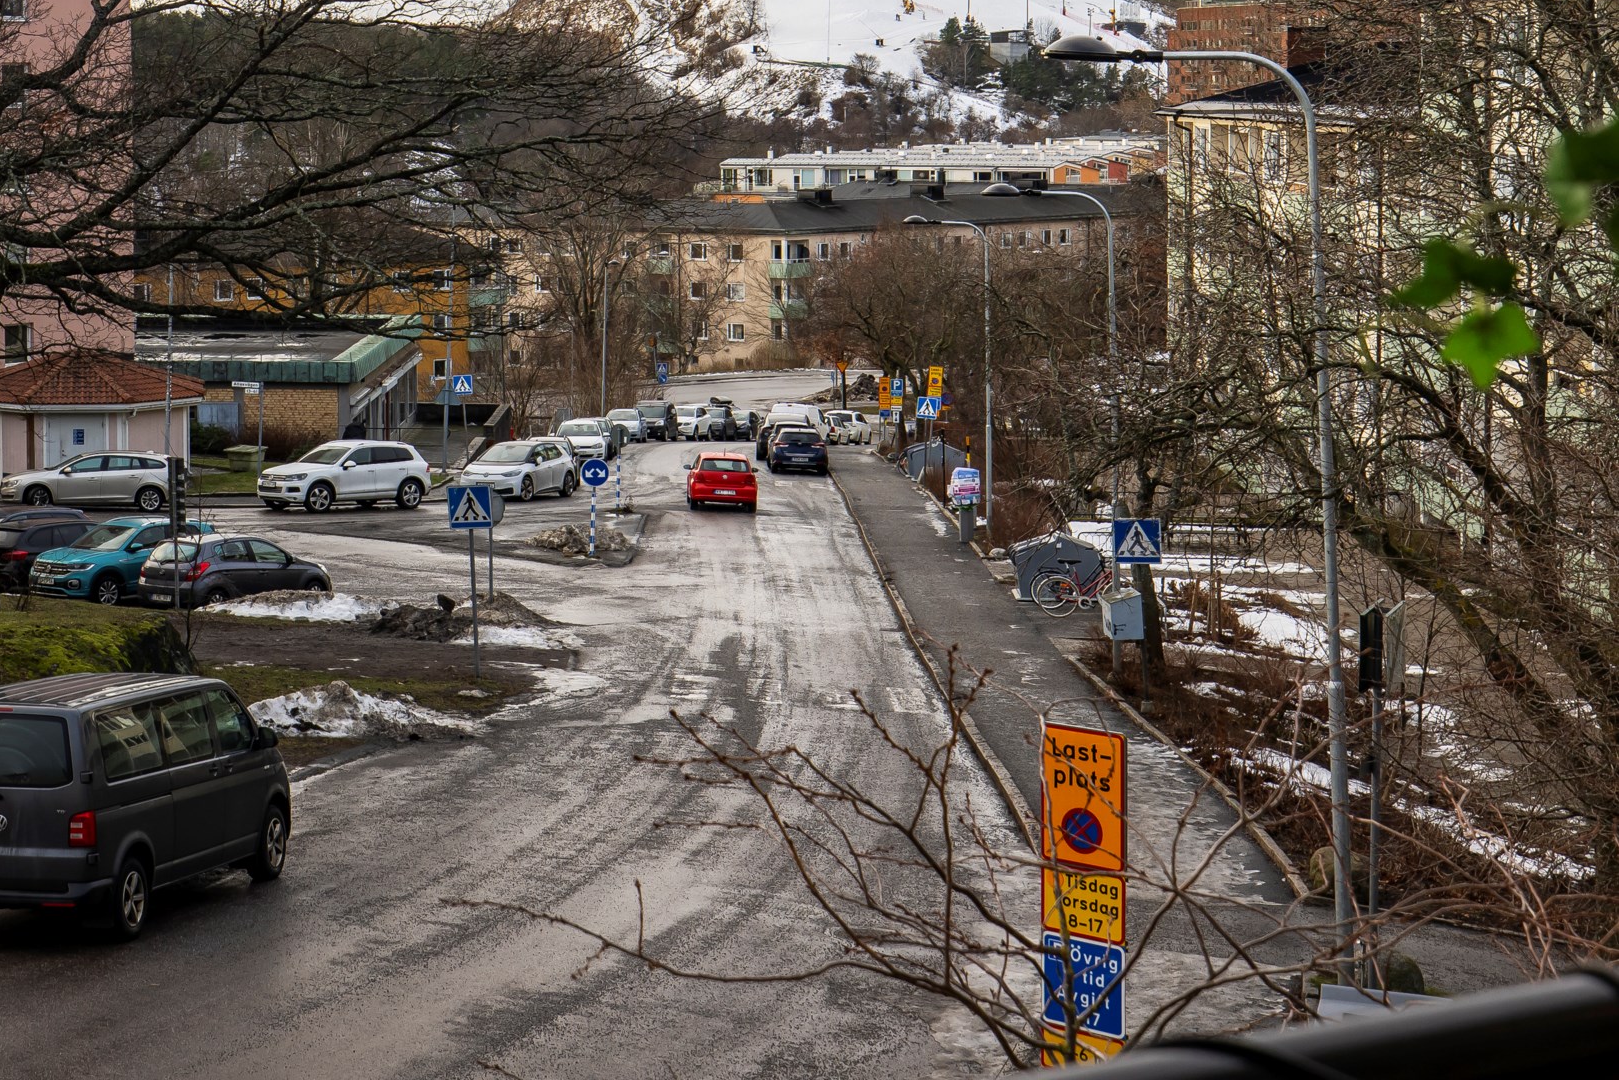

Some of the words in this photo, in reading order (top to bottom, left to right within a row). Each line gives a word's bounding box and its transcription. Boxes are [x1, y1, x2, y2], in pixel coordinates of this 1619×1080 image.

[893, 380, 901, 390] P
[1052, 737, 1112, 763] Last-
[1054, 766, 1111, 792] plats
[1065, 873, 1119, 900] Tisdag
[1061, 895, 1119, 920] orsdag
[1068, 913, 1103, 933] 8-17
[1070, 943, 1118, 973] Övrig
[1082, 970, 1105, 988] tid
